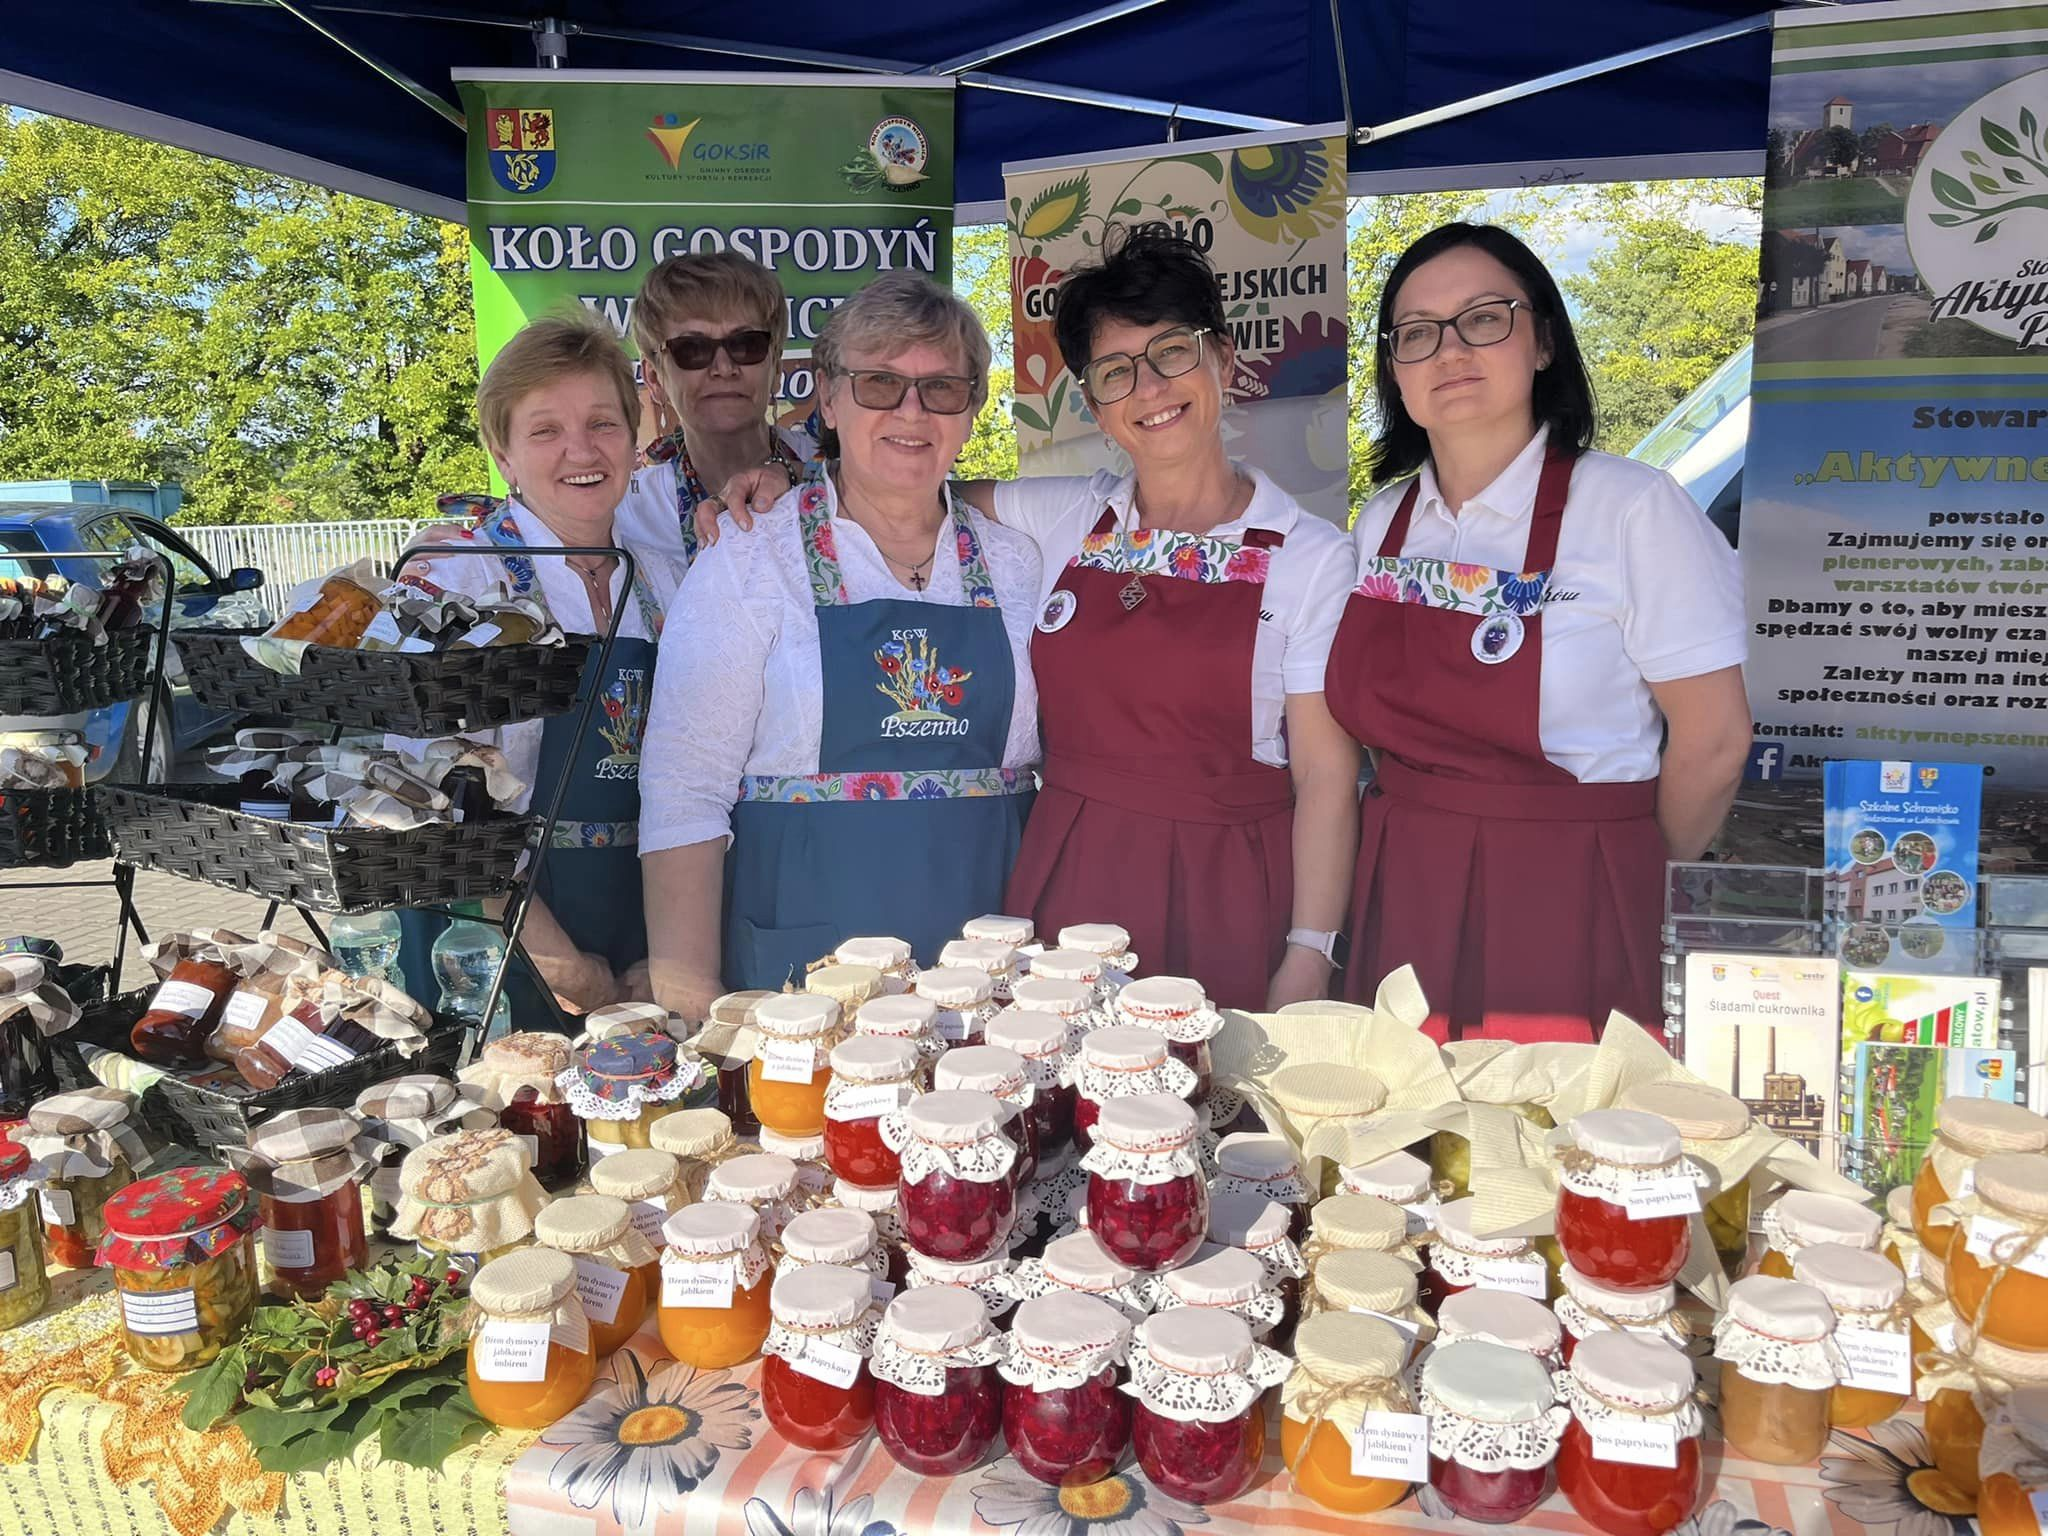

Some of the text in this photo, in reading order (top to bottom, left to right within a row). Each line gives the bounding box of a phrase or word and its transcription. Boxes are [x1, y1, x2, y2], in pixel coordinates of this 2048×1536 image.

[488, 218, 938, 273] KOŁO GOSPODYŃ
[1214, 263, 1328, 303] EJSKICH
[1928, 509, 2045, 528] powstało
[1827, 531, 1975, 551] Zajmujemy
[1981, 533, 2017, 552] się
[1823, 555, 2048, 574] plenerowych, zab
[1834, 578, 1981, 594] warsztatów
[1768, 599, 2048, 620] Dbamy o to, aby miesz
[891, 628, 928, 641] KGW
[1755, 622, 1852, 639] spędzać
[1860, 623, 1918, 641] swój
[1926, 625, 1999, 643] wolny
[1906, 647, 1988, 665] naszej
[618, 668, 644, 681] KGW
[1823, 665, 1905, 685] Zależy
[1911, 671, 1968, 685] nam
[1974, 672, 2005, 686] na
[1778, 687, 1937, 707] społeczności
[1943, 694, 2000, 708] oraz
[880, 715, 970, 738] Pszenno
[594, 758, 638, 780] Psze
[1752, 989, 1781, 1001] Quest
[1709, 998, 1826, 1017] Śladami cukrownika
[505, 1336, 539, 1348] dyniowy
[1614, 1438, 1669, 1453] paprykowy
